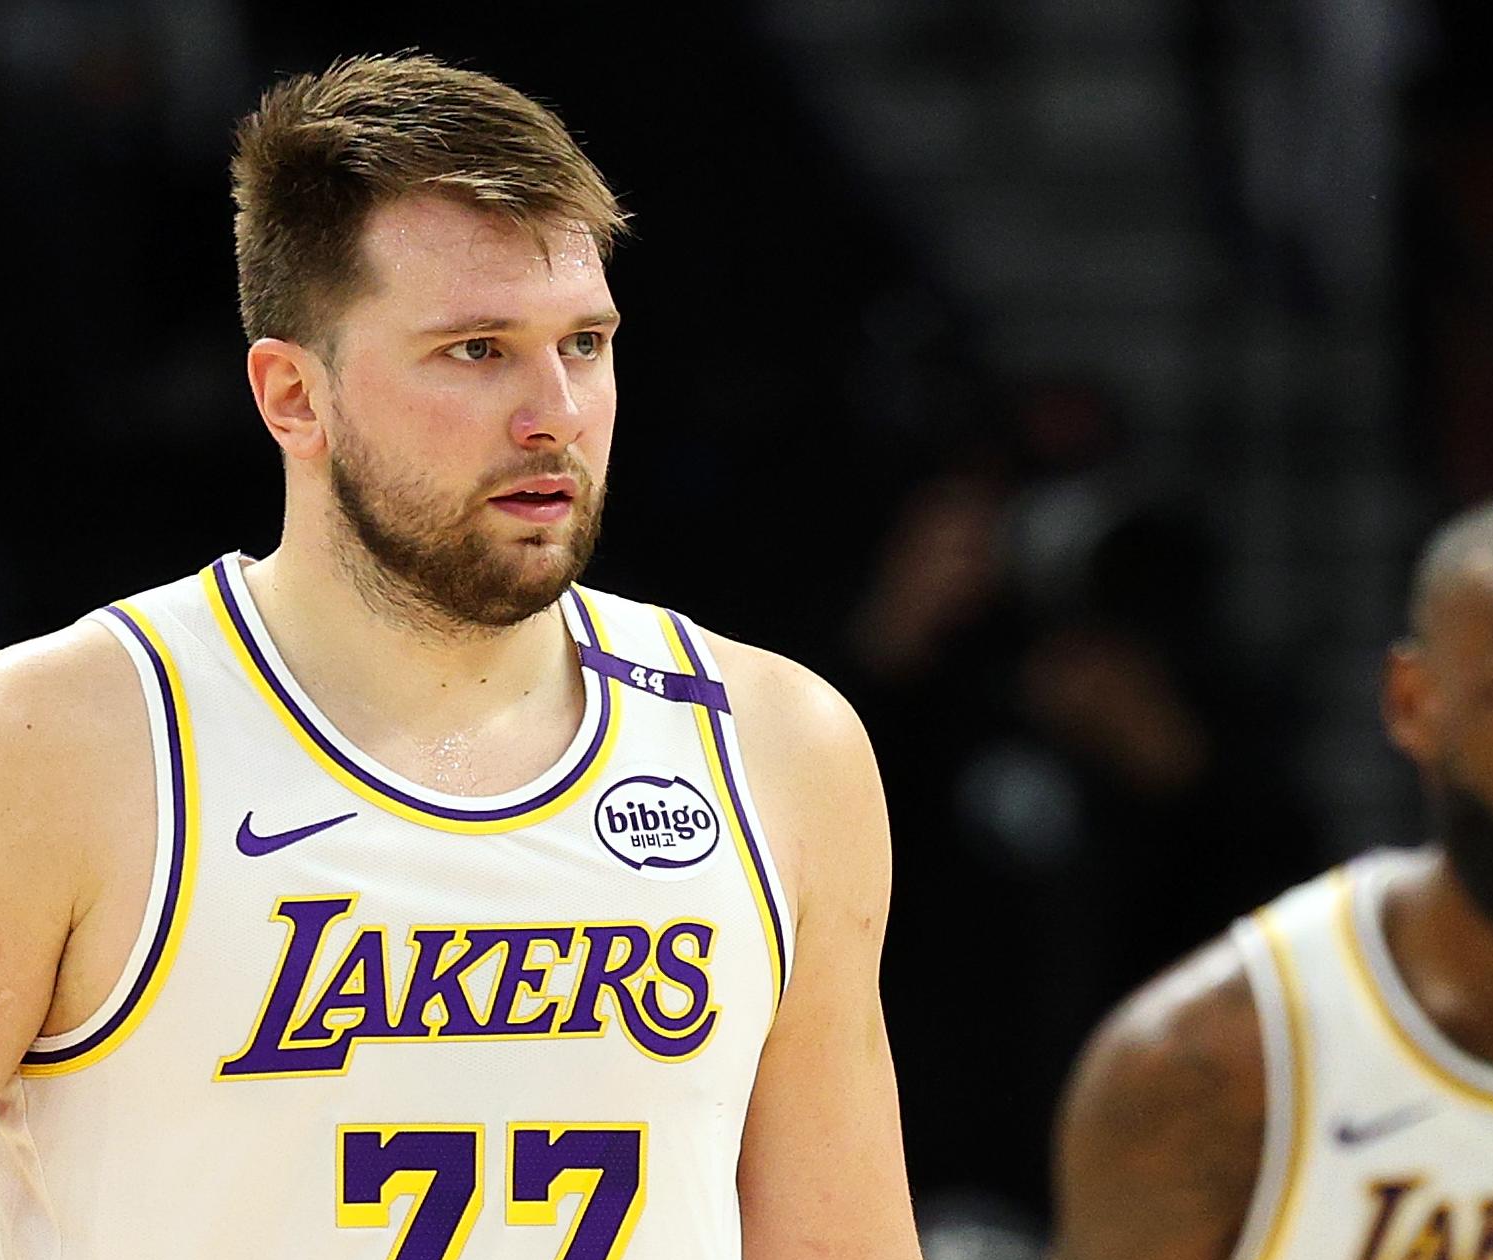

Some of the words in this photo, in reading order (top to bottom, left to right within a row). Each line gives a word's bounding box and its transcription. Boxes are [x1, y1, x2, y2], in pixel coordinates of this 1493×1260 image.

[629, 666, 665, 695] 44
[606, 801, 711, 840] bibigo
[630, 832, 676, 849] 비비고
[213, 893, 722, 1081] LAKERS
